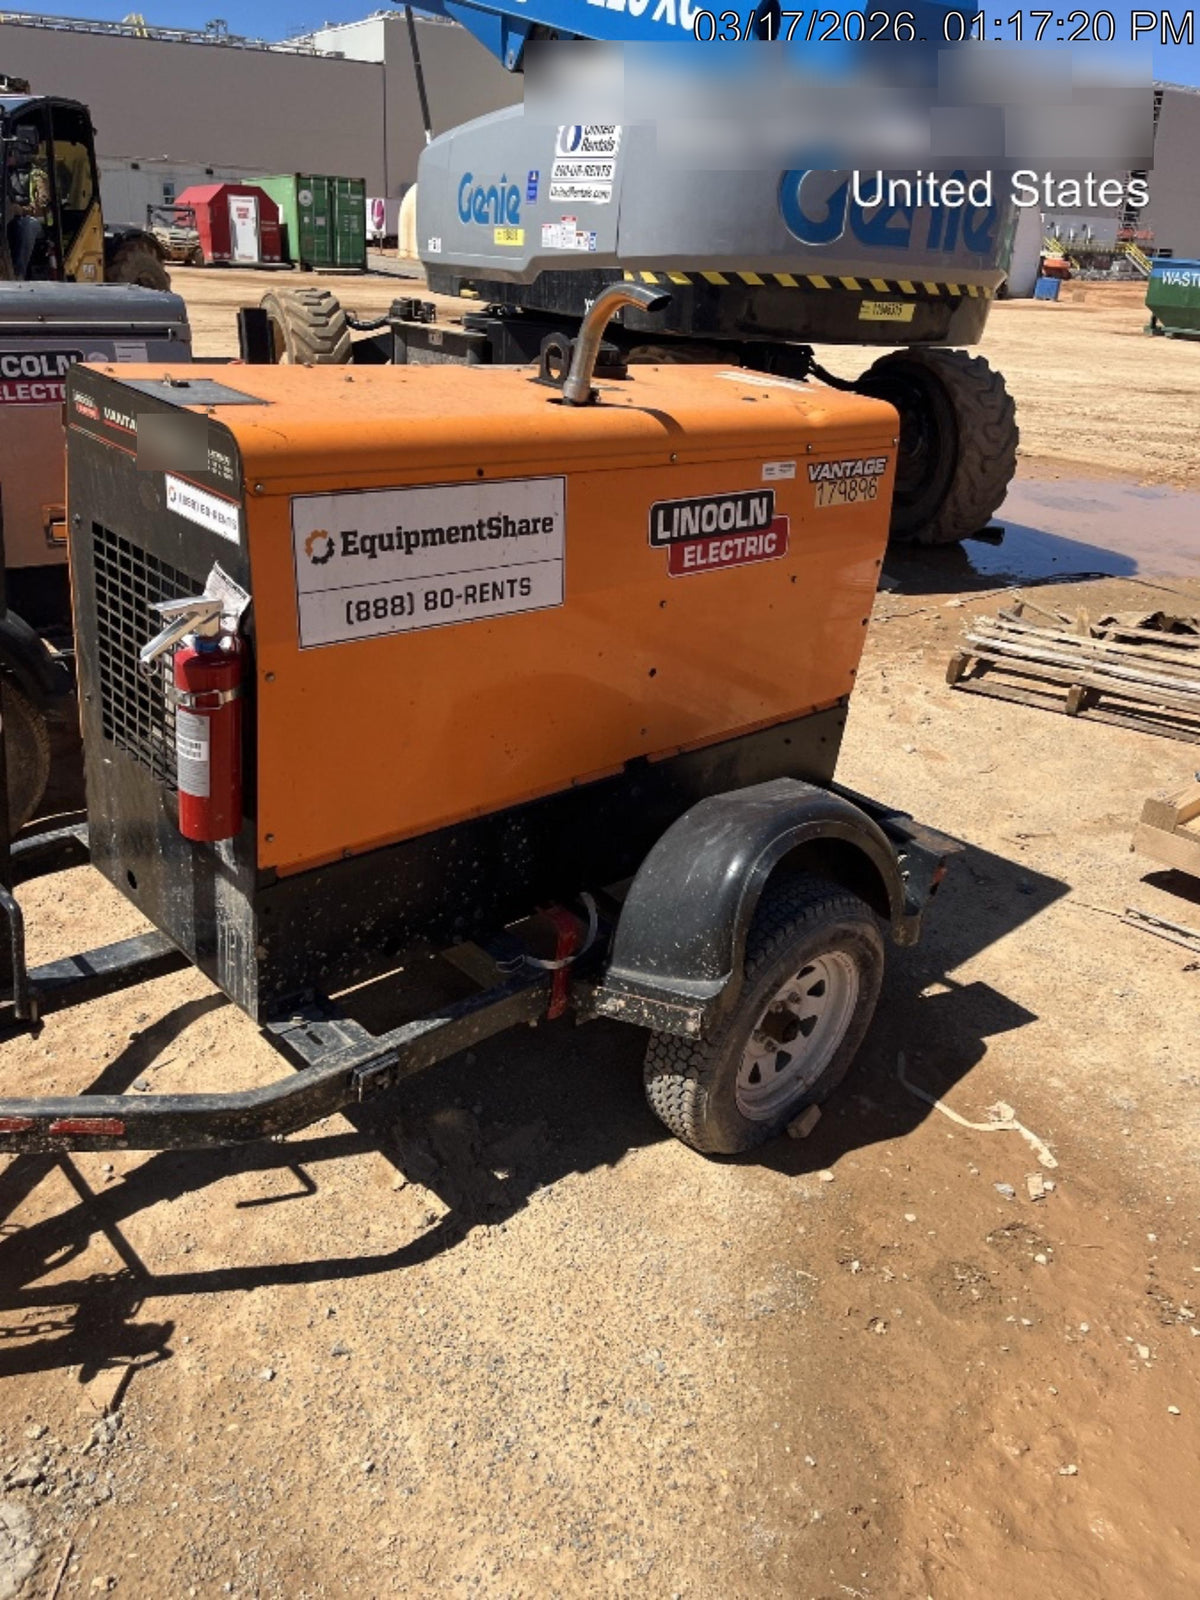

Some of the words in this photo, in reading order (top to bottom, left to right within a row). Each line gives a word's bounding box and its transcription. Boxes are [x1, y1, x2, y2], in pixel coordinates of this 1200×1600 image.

[458, 172, 521, 225] Genie
[778, 169, 996, 253] Genie
[1162, 271, 1200, 288] WAST
[0, 383, 66, 401] LECT
[808, 457, 888, 481] VANTAGE
[340, 515, 554, 559] EquipmentShare
[683, 533, 778, 568] ELECTRIC
[346, 591, 414, 625] (888)
[424, 577, 532, 611] 80-RENTS
